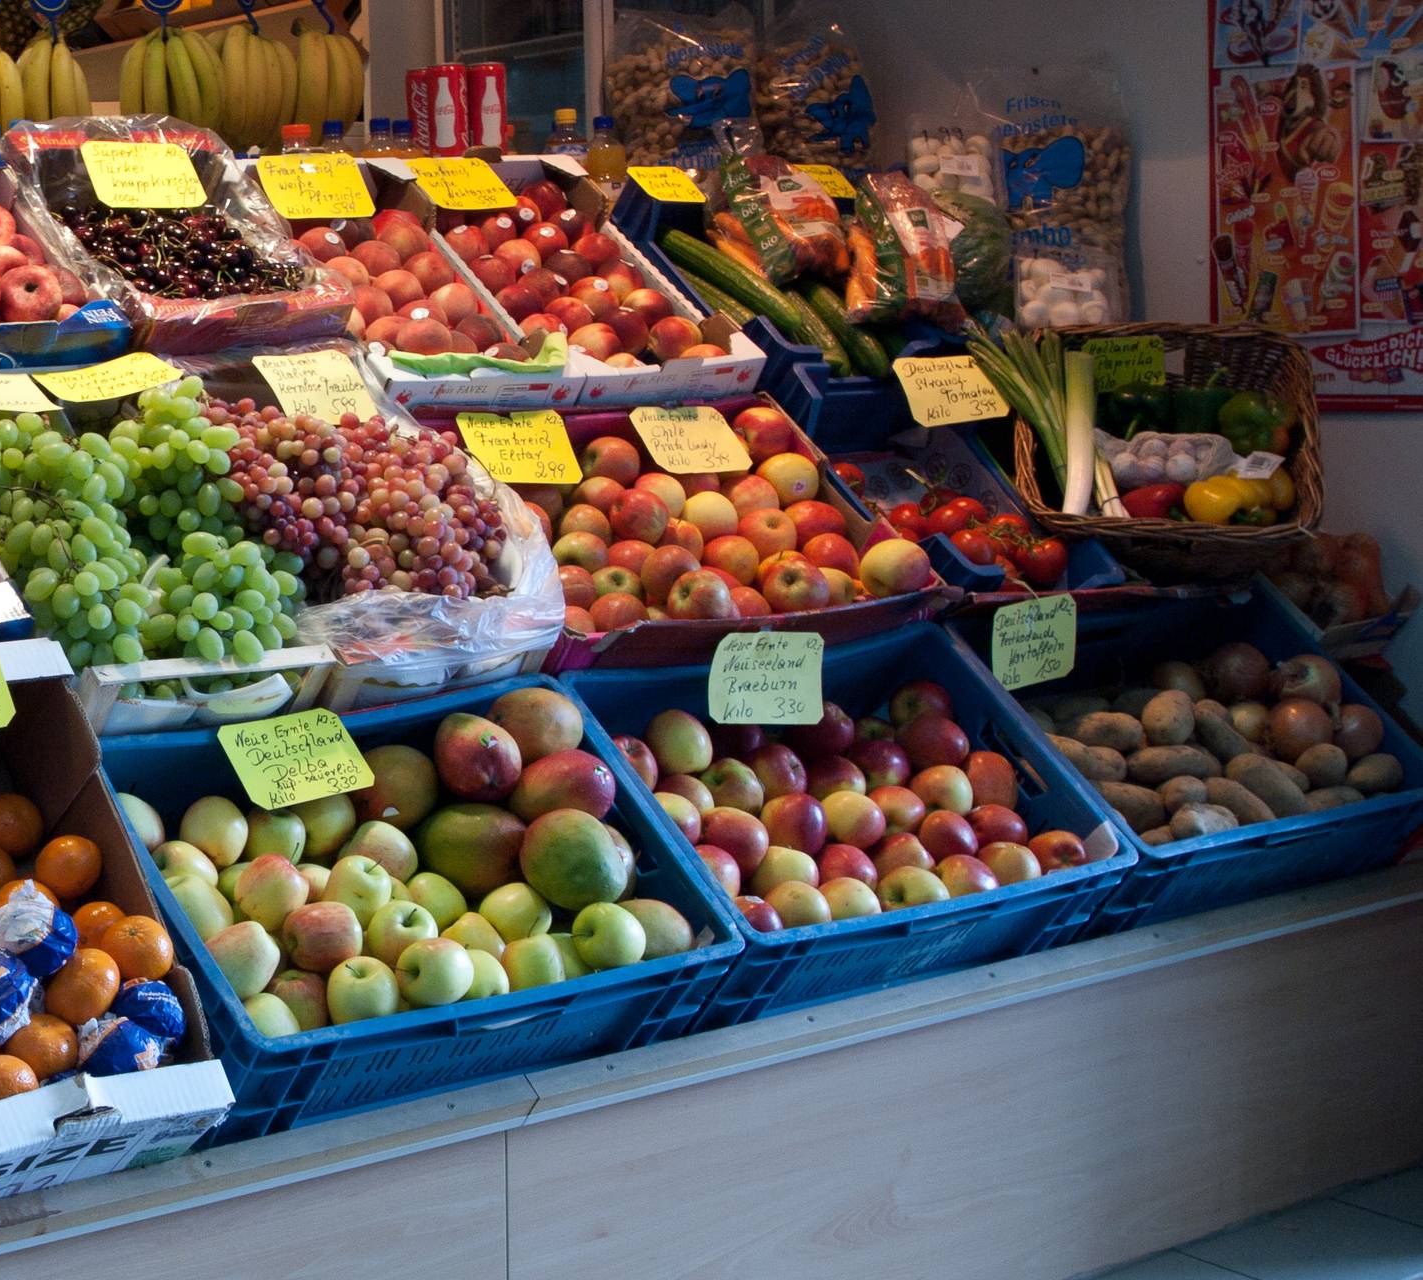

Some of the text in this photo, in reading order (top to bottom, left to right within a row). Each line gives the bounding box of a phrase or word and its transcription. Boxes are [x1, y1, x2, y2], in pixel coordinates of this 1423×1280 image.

[723, 674, 799, 695] Braeburn
[723, 699, 754, 721] Kilo
[262, 757, 329, 784] Delba
[269, 789, 296, 809] Kilo
